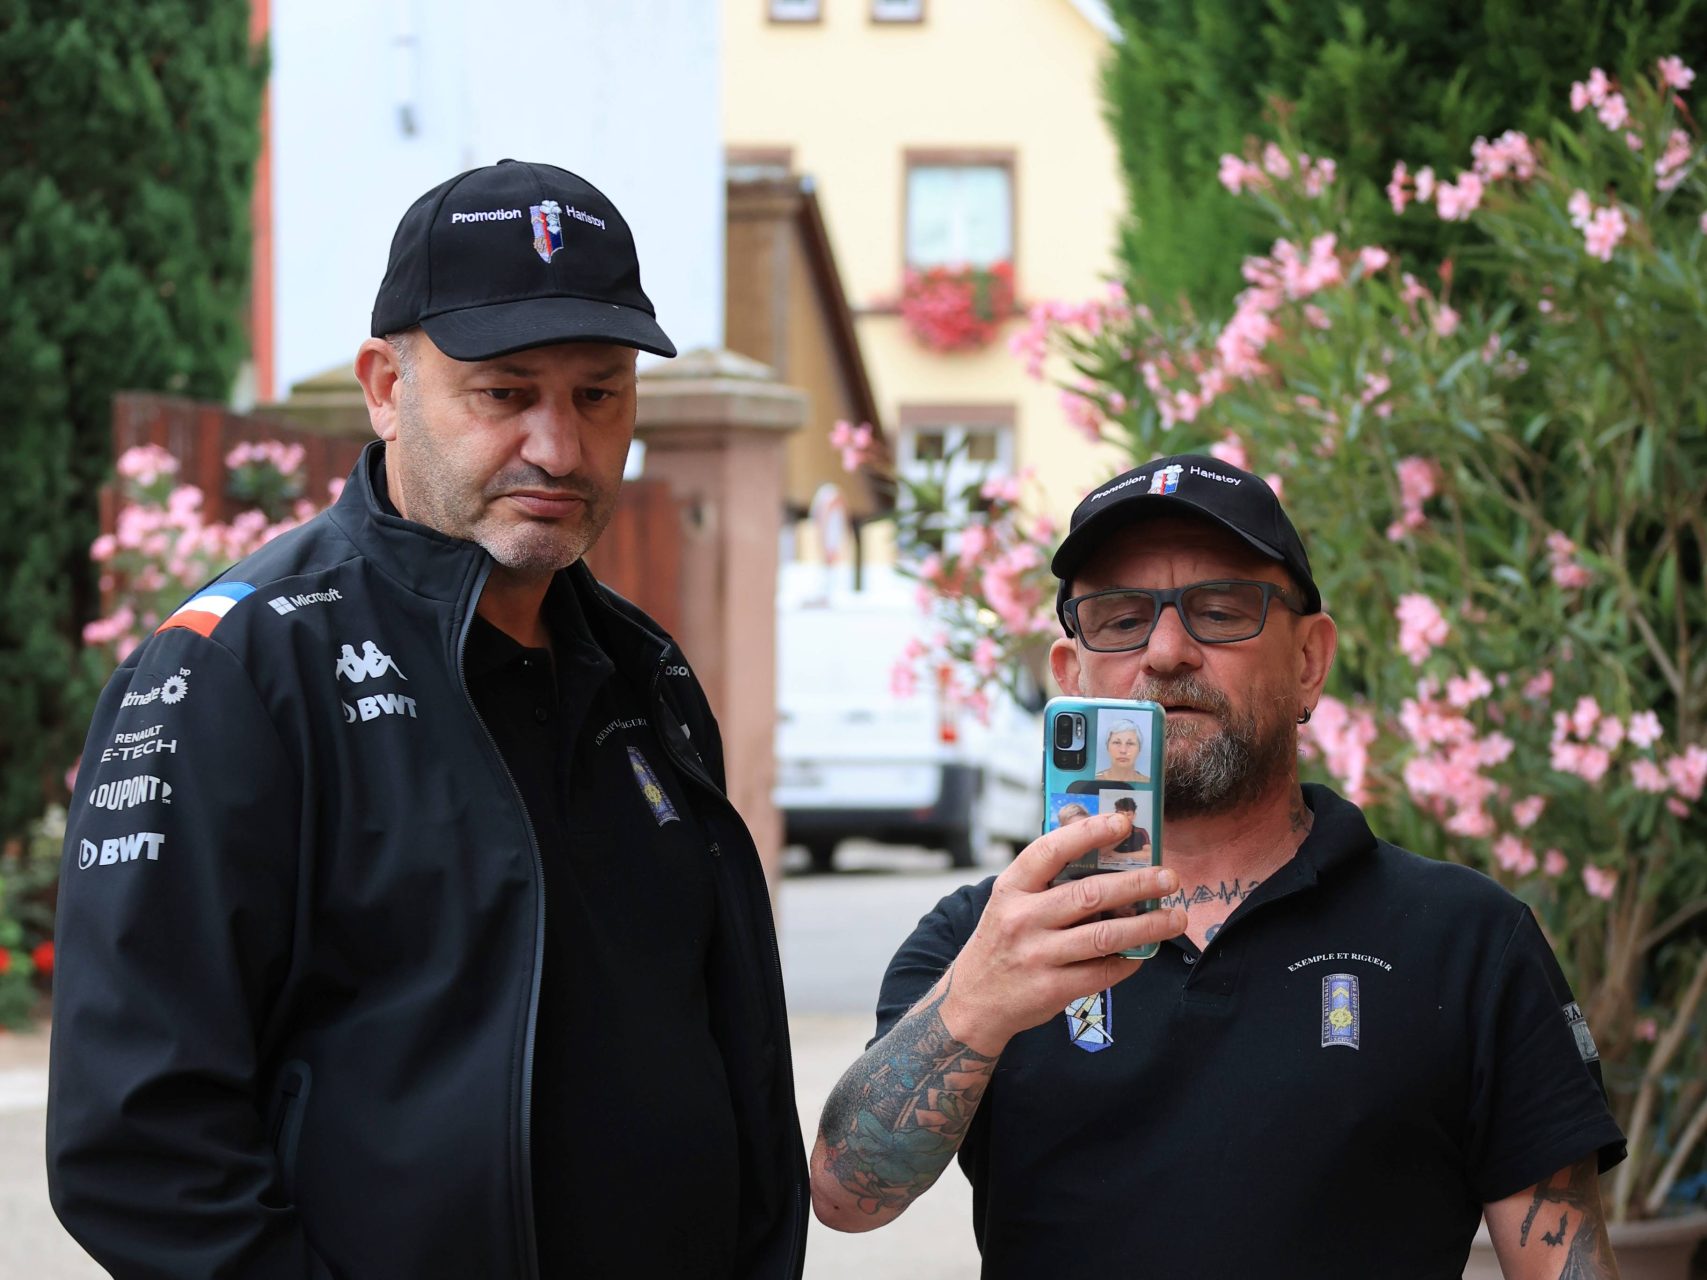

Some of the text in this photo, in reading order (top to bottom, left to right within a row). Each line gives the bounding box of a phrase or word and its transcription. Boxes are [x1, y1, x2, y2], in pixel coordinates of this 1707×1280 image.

[452, 208, 522, 224] Promotion
[1091, 465, 1242, 502] Promotion Haristoy
[289, 588, 343, 608] Microsoft
[180, 667, 191, 676] bp
[357, 693, 417, 722] BWT
[115, 724, 164, 744] RENAULT
[100, 739, 178, 763] E-TECH
[95, 774, 161, 811] DUPONT
[98, 831, 166, 867] BWT
[1287, 952, 1393, 972] EXEMPLE ET RIGUEUR
